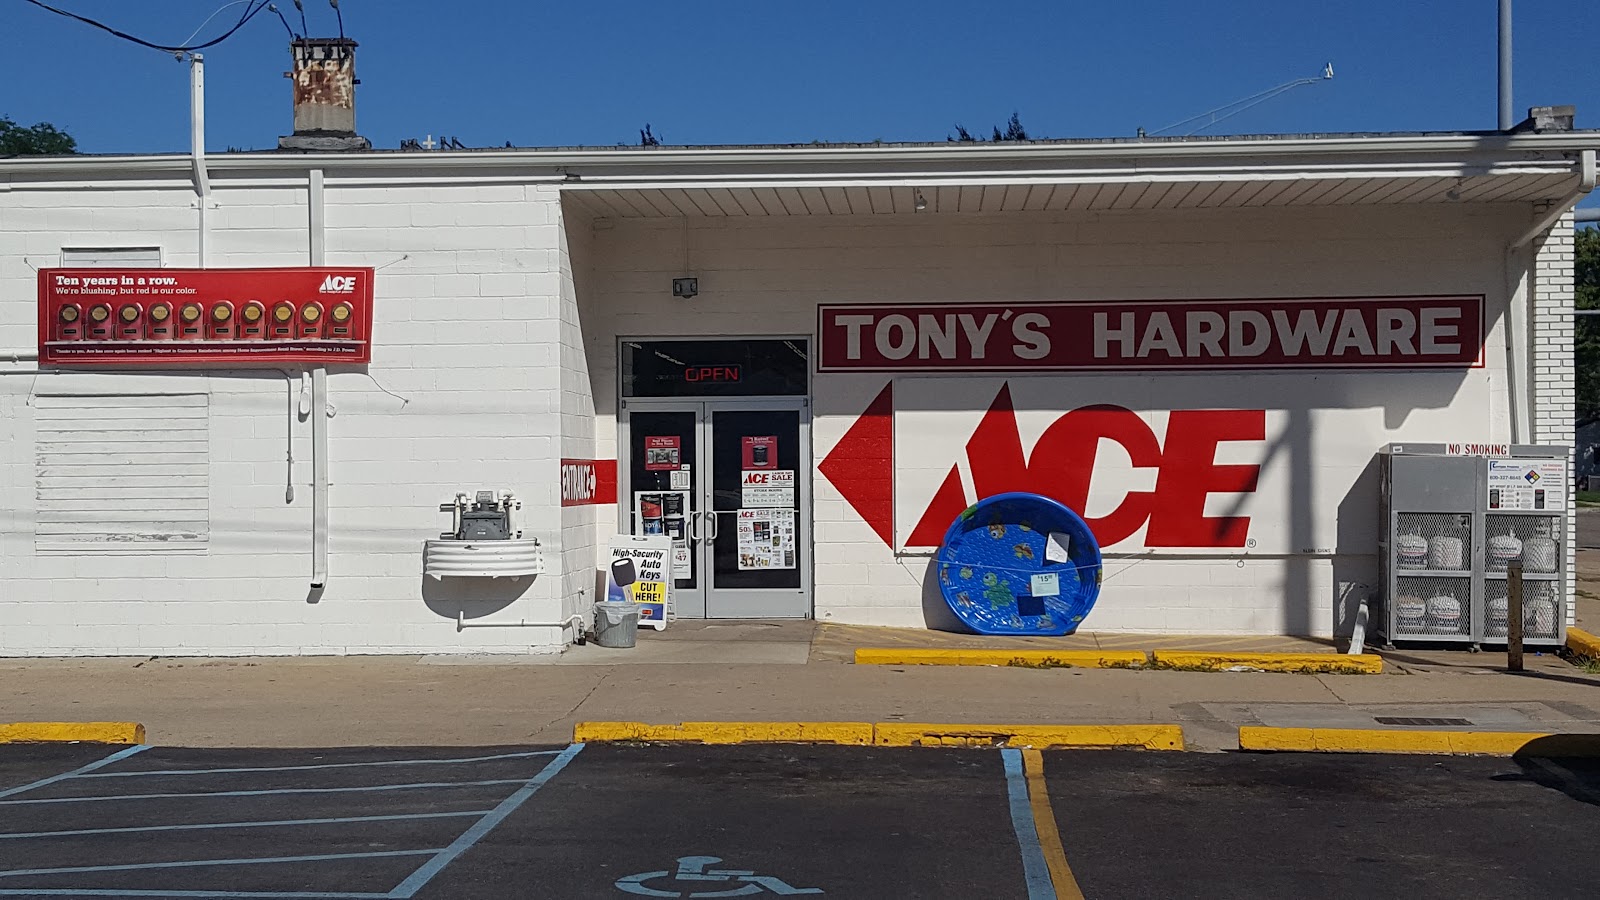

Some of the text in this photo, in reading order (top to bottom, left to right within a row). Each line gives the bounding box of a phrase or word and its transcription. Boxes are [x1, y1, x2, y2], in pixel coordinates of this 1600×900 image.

[56, 276, 79, 285] Ten
[83, 277, 118, 287] years
[121, 276, 134, 285] in
[319, 274, 356, 290] ACE
[81, 288, 118, 296] blushing,
[834, 306, 1461, 361] TONY'S HARDWARE
[685, 367, 738, 382] OPEN
[1448, 444, 1507, 454] NO SMOKING
[905, 381, 1266, 549] ACE
[562, 464, 590, 501] ENTRANCE
[744, 472, 769, 484] ACE
[612, 548, 663, 560] High-Security
[640, 559, 661, 569] Auto
[640, 570, 661, 580] Keys
[640, 582, 657, 592] CUT
[635, 592, 661, 602] HERE!
